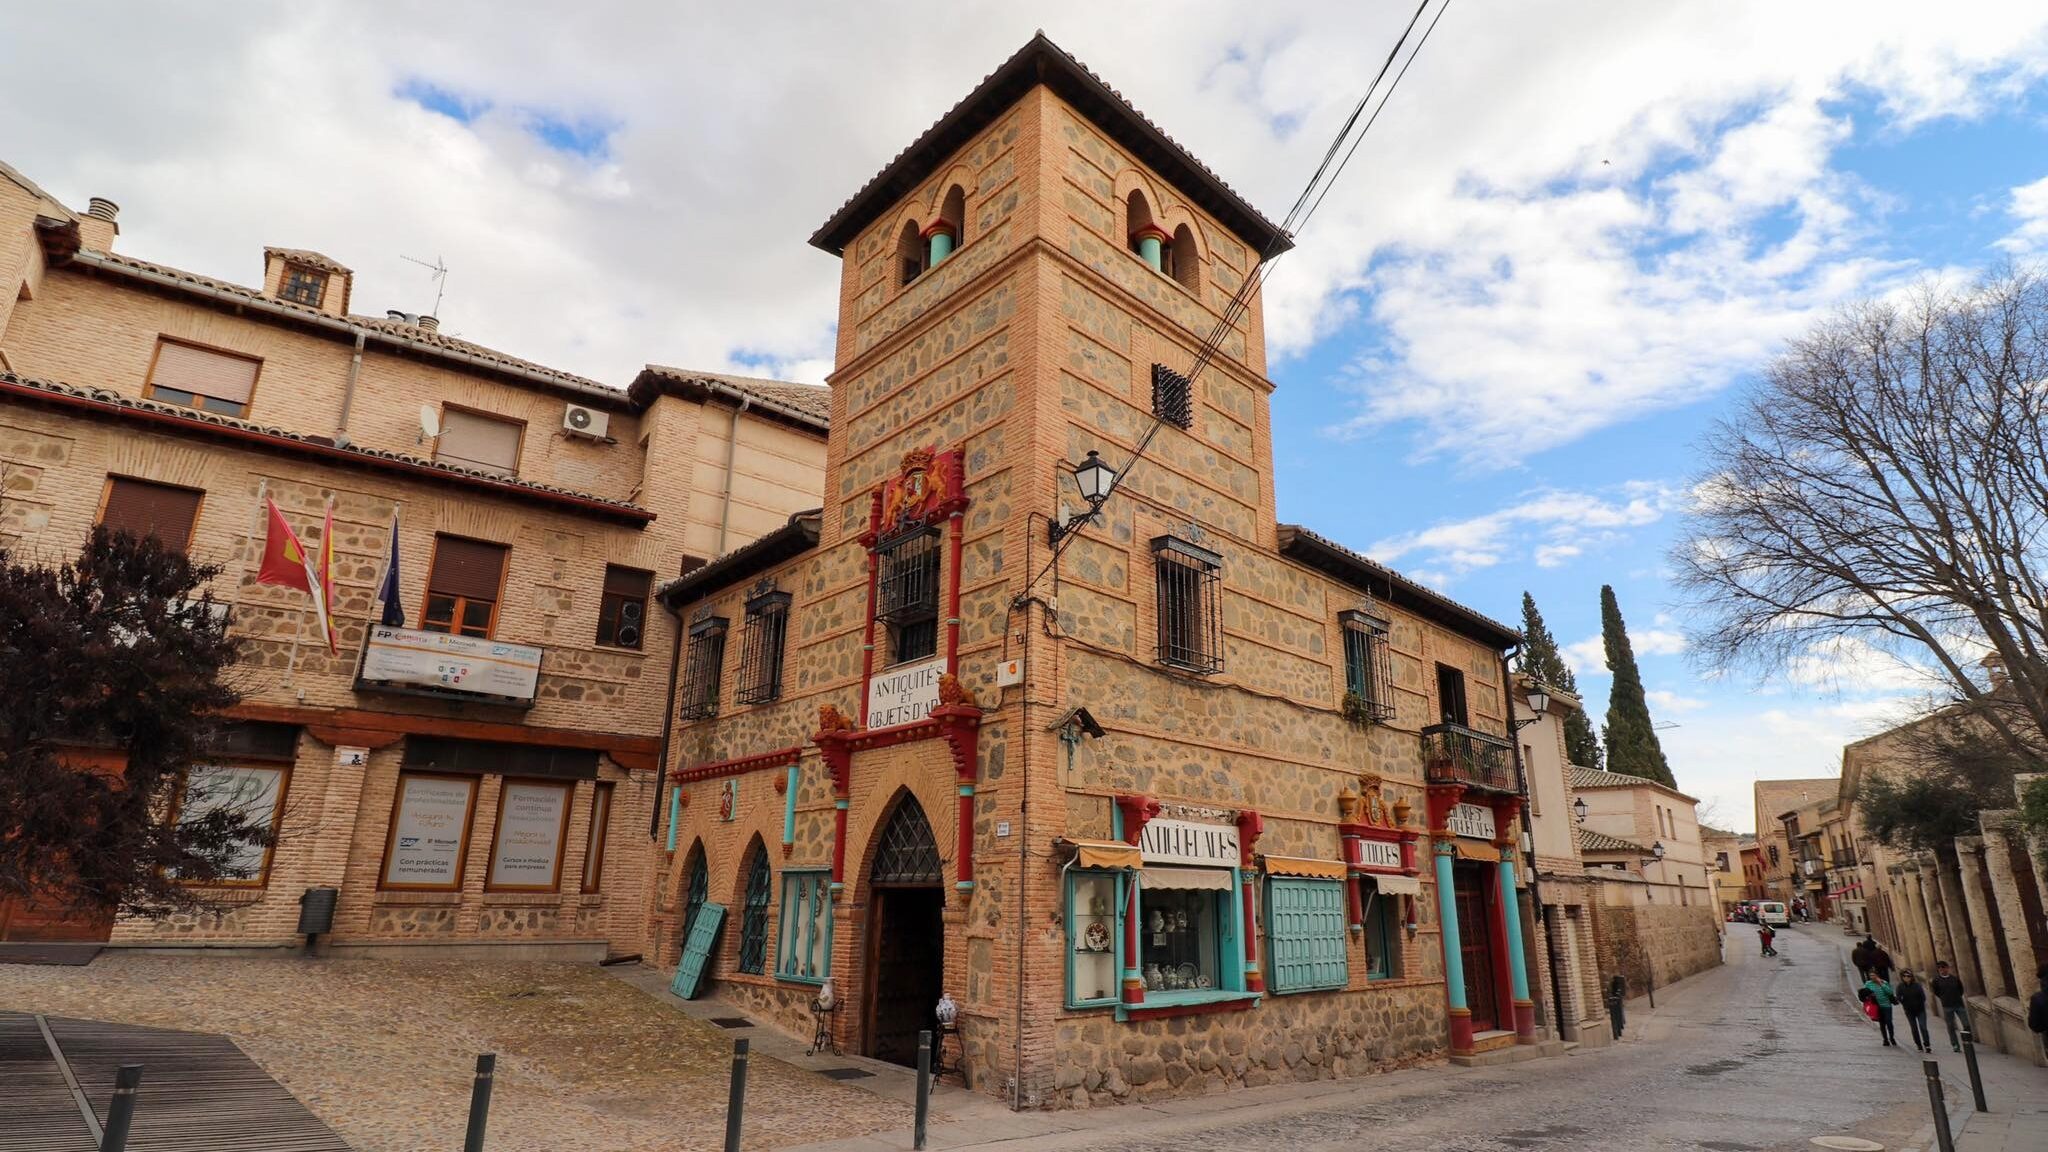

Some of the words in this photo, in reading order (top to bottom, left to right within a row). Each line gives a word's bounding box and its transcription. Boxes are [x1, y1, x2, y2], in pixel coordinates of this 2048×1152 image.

[377, 630, 392, 639] FP
[875, 664, 943, 698] ANTIQUITÉS
[901, 692, 913, 704] ET
[869, 704, 911, 729] OBJETS
